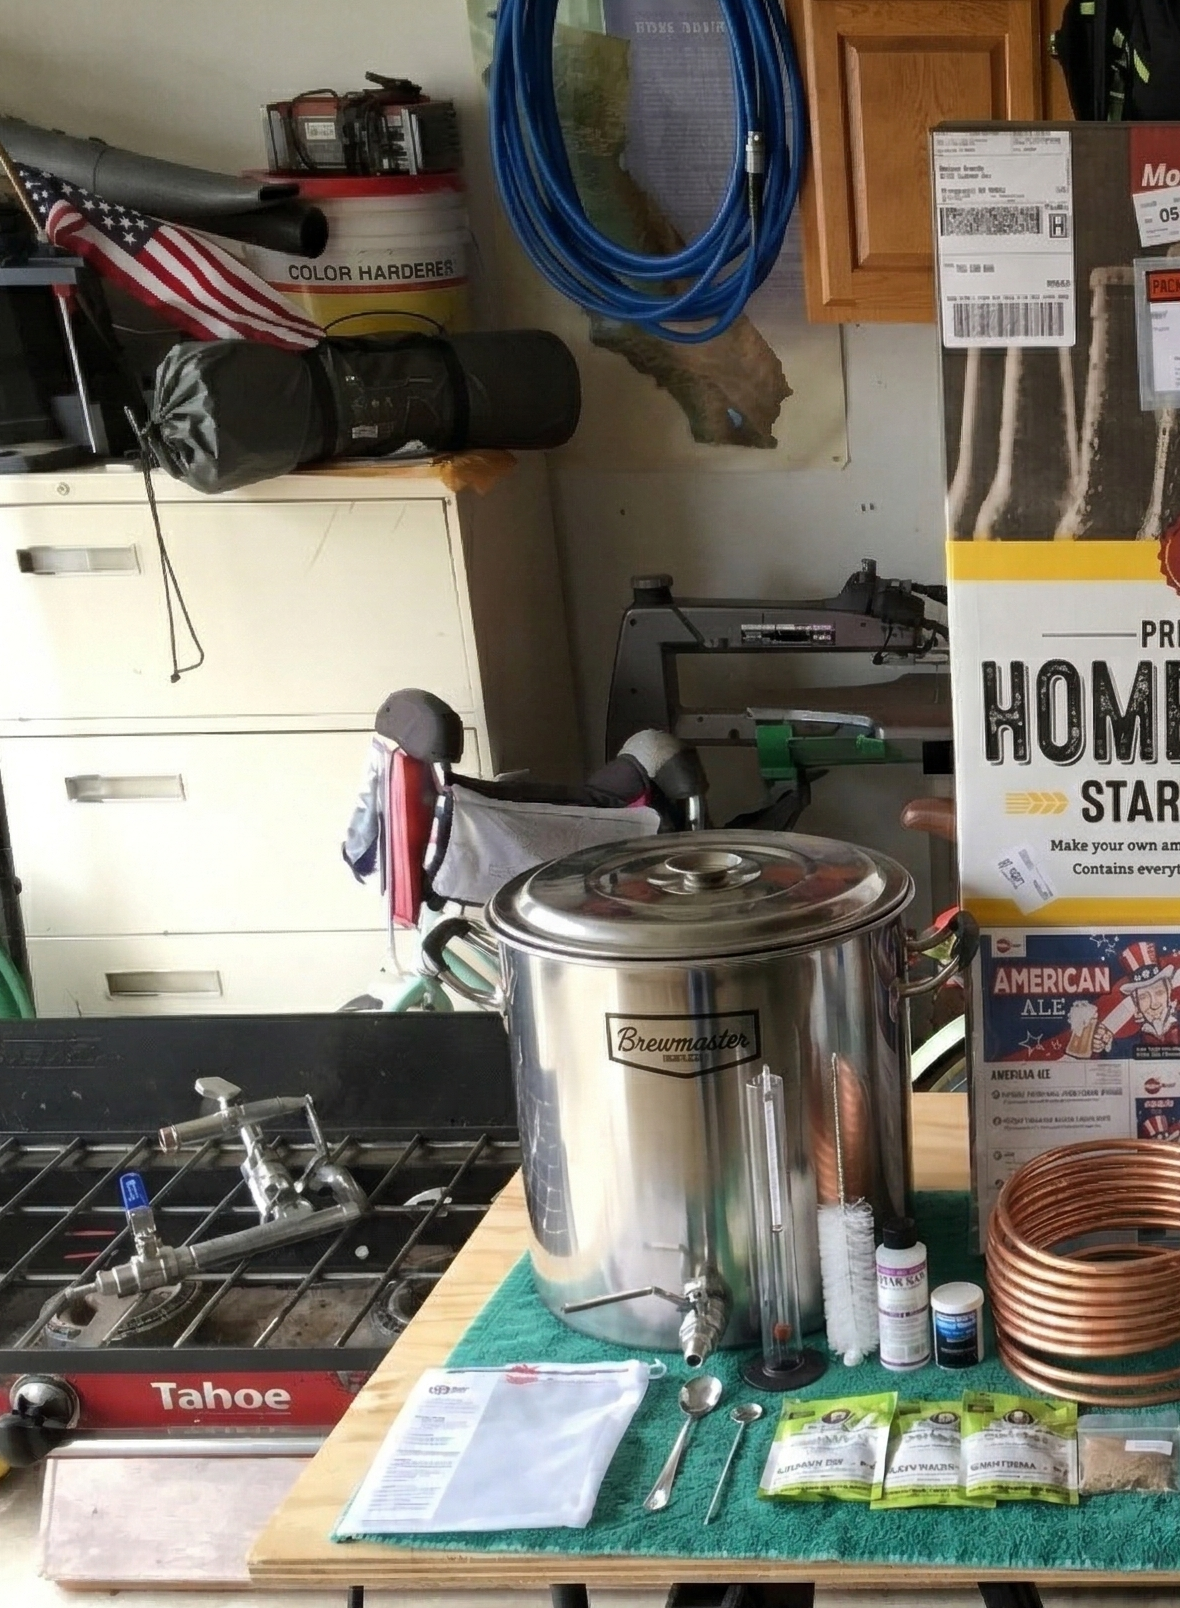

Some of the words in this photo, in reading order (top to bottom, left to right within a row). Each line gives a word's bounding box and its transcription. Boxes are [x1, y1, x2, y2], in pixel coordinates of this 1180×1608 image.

[288, 264, 352, 281] COLOR
[1050, 838, 1089, 853] Make
[1091, 840, 1125, 855] your
[1127, 840, 1158, 852] own
[1072, 862, 1135, 876] Contains
[993, 966, 1111, 994] AMERICAN
[1021, 998, 1065, 1016] ALE
[617, 1026, 750, 1053] Brewmaster
[150, 1381, 292, 1410] Tahoe
